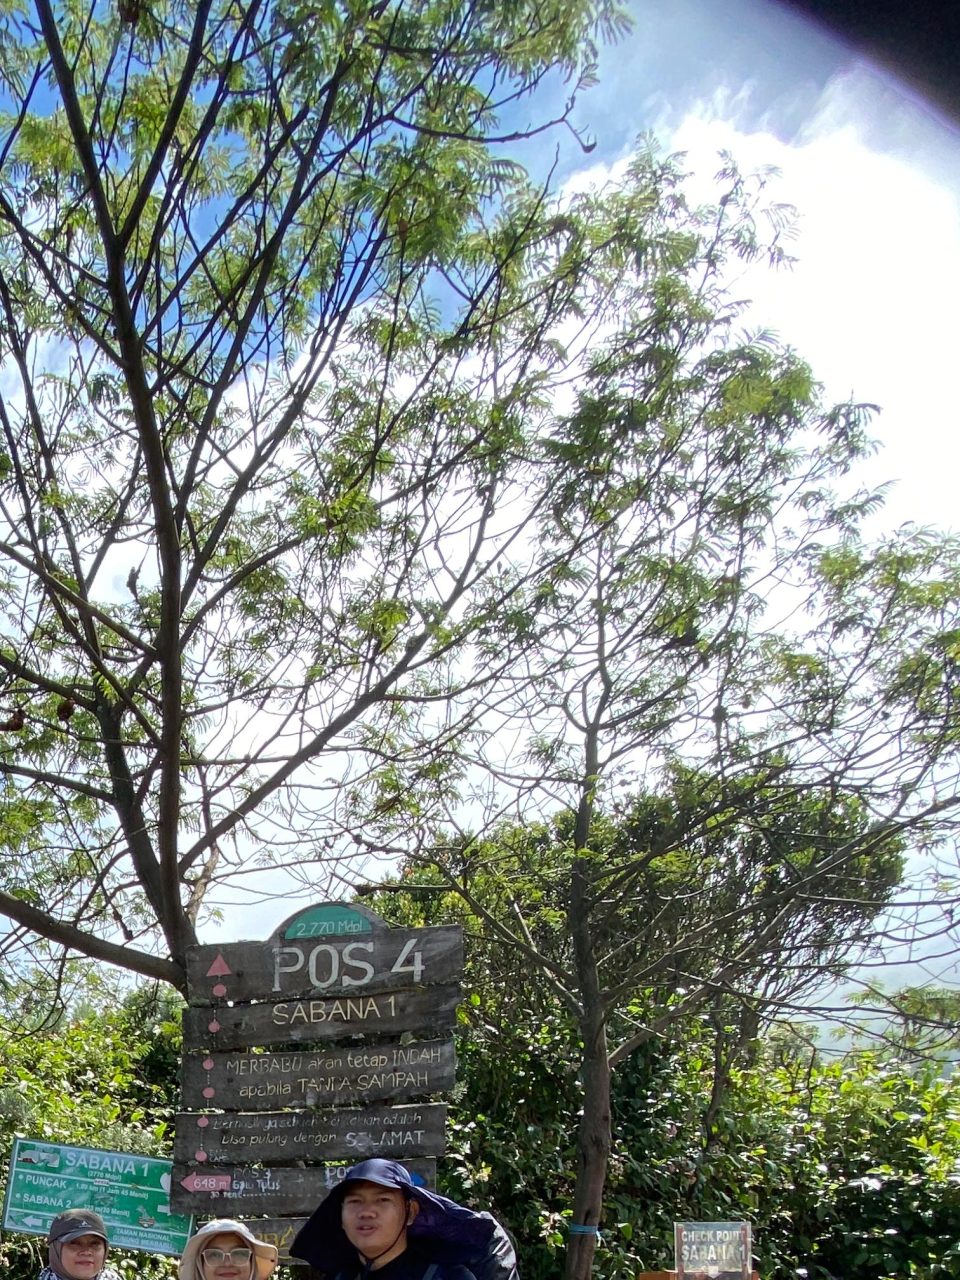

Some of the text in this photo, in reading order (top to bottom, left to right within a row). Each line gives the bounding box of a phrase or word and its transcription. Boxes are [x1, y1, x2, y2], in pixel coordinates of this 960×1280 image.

[271, 938, 426, 992] POS 4
[272, 995, 396, 1025] SABANA 1
[226, 1056, 303, 1076] MERBABU
[347, 1052, 388, 1071] tetap
[392, 1048, 441, 1067] INDAH
[356, 1071, 428, 1091] SAMPAH
[65, 1152, 149, 1177] SABANA 1
[25, 1174, 67, 1189] PUNCAK
[193, 1178, 228, 1189] 648 m
[23, 1193, 64, 1208] SABANA
[65, 1199, 72, 1209] 2
[682, 1230, 713, 1242] CHECK
[739, 1244, 746, 1260] 1
